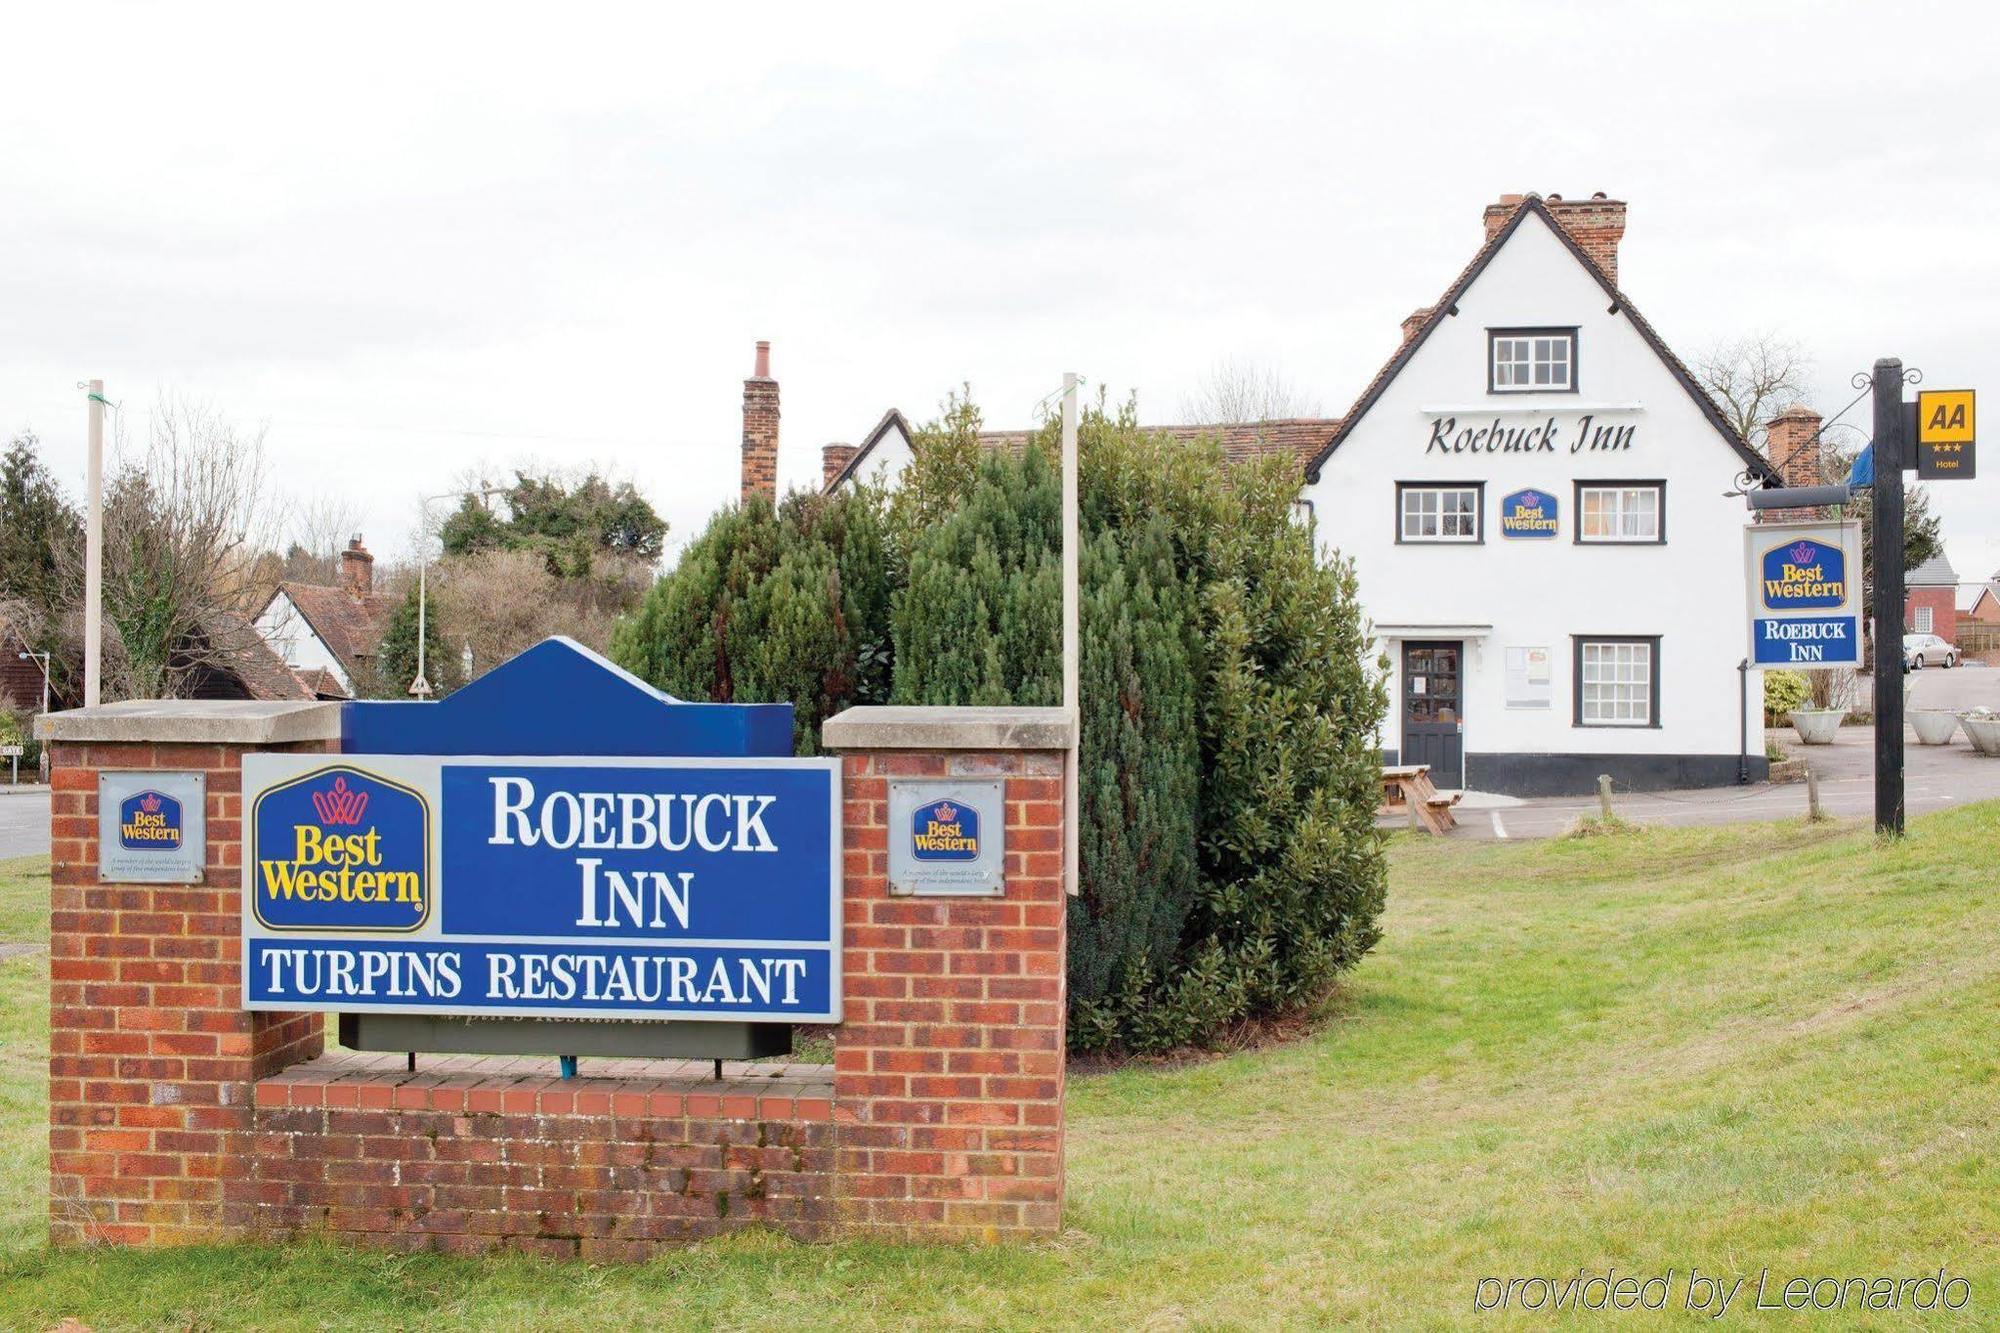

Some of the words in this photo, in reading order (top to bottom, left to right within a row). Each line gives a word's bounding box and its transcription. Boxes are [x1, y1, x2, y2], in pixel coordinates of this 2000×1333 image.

[1928, 404, 1966, 430] AA
[1425, 416, 1558, 455] Roebuck
[1570, 415, 1637, 454] Inn
[1935, 459, 1960, 469] Hotel
[1515, 505, 1544, 519] Best
[1503, 516, 1556, 530] Western
[1782, 563, 1824, 583] Best
[1765, 579, 1843, 598] Western
[1764, 620, 1846, 640] ROEBUCK
[1789, 642, 1823, 662] INN
[134, 811, 166, 827] Best
[487, 775, 779, 853] ROEBUCK
[122, 824, 179, 840] Western
[928, 821, 962, 837] Best
[294, 825, 382, 866] Best
[914, 834, 977, 851] Western
[260, 860, 423, 902] Western
[575, 857, 695, 930] INN
[261, 948, 462, 998] TURPINS
[485, 952, 806, 1005] RESTAURANT
